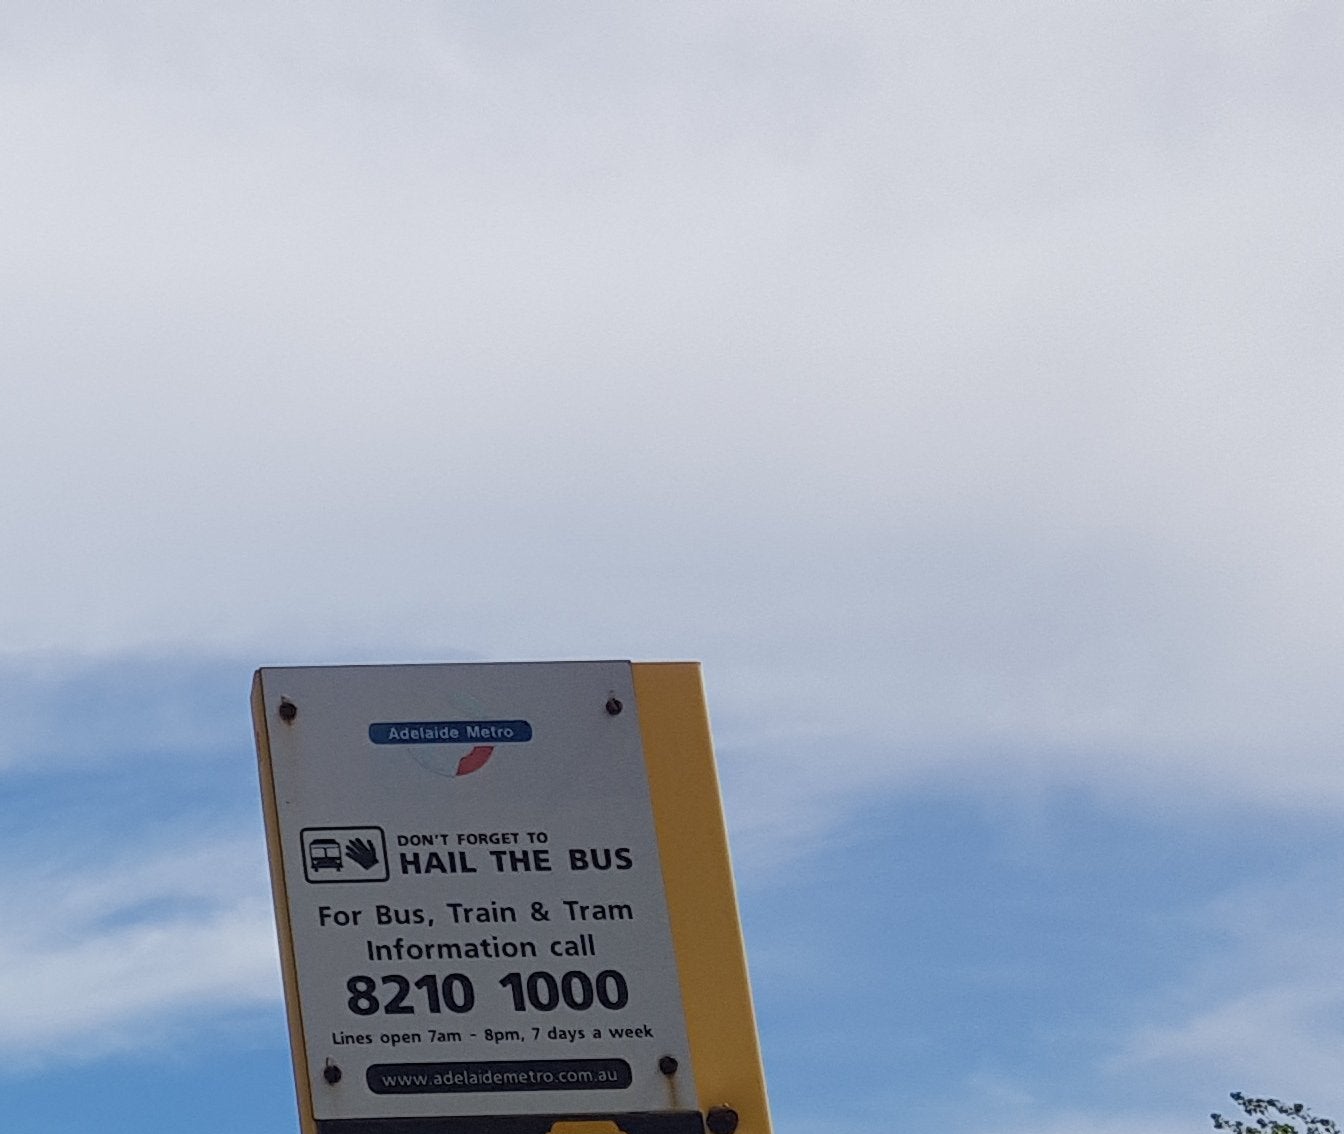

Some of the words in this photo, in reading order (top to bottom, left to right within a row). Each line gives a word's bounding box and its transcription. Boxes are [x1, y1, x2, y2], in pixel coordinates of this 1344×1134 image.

[388, 725, 460, 740] Adelaide
[466, 724, 514, 739] Metro
[397, 834, 449, 847] DON'T
[457, 832, 519, 846] FORGET
[526, 831, 549, 845] TO
[400, 851, 477, 875] HAIL
[489, 849, 552, 873] THE
[569, 847, 634, 871] BUS
[318, 905, 362, 927] For
[376, 904, 435, 928] Bus,
[446, 901, 517, 925] Train
[530, 902, 552, 922] &
[562, 899, 634, 921] Tram
[367, 936, 537, 961] Information
[550, 933, 596, 957] call
[346, 973, 475, 1017] 8210
[499, 969, 630, 1013] 1000
[332, 1031, 373, 1046] Lines
[380, 1032, 422, 1049] open
[428, 1030, 462, 1044] 7am
[484, 1028, 526, 1047] 8pm,
[531, 1028, 541, 1041] 7
[546, 1026, 586, 1045] days
[592, 1029, 602, 1040] a
[609, 1025, 655, 1039] week
[382, 1069, 619, 1088] www.adelaidemetro.com.au
